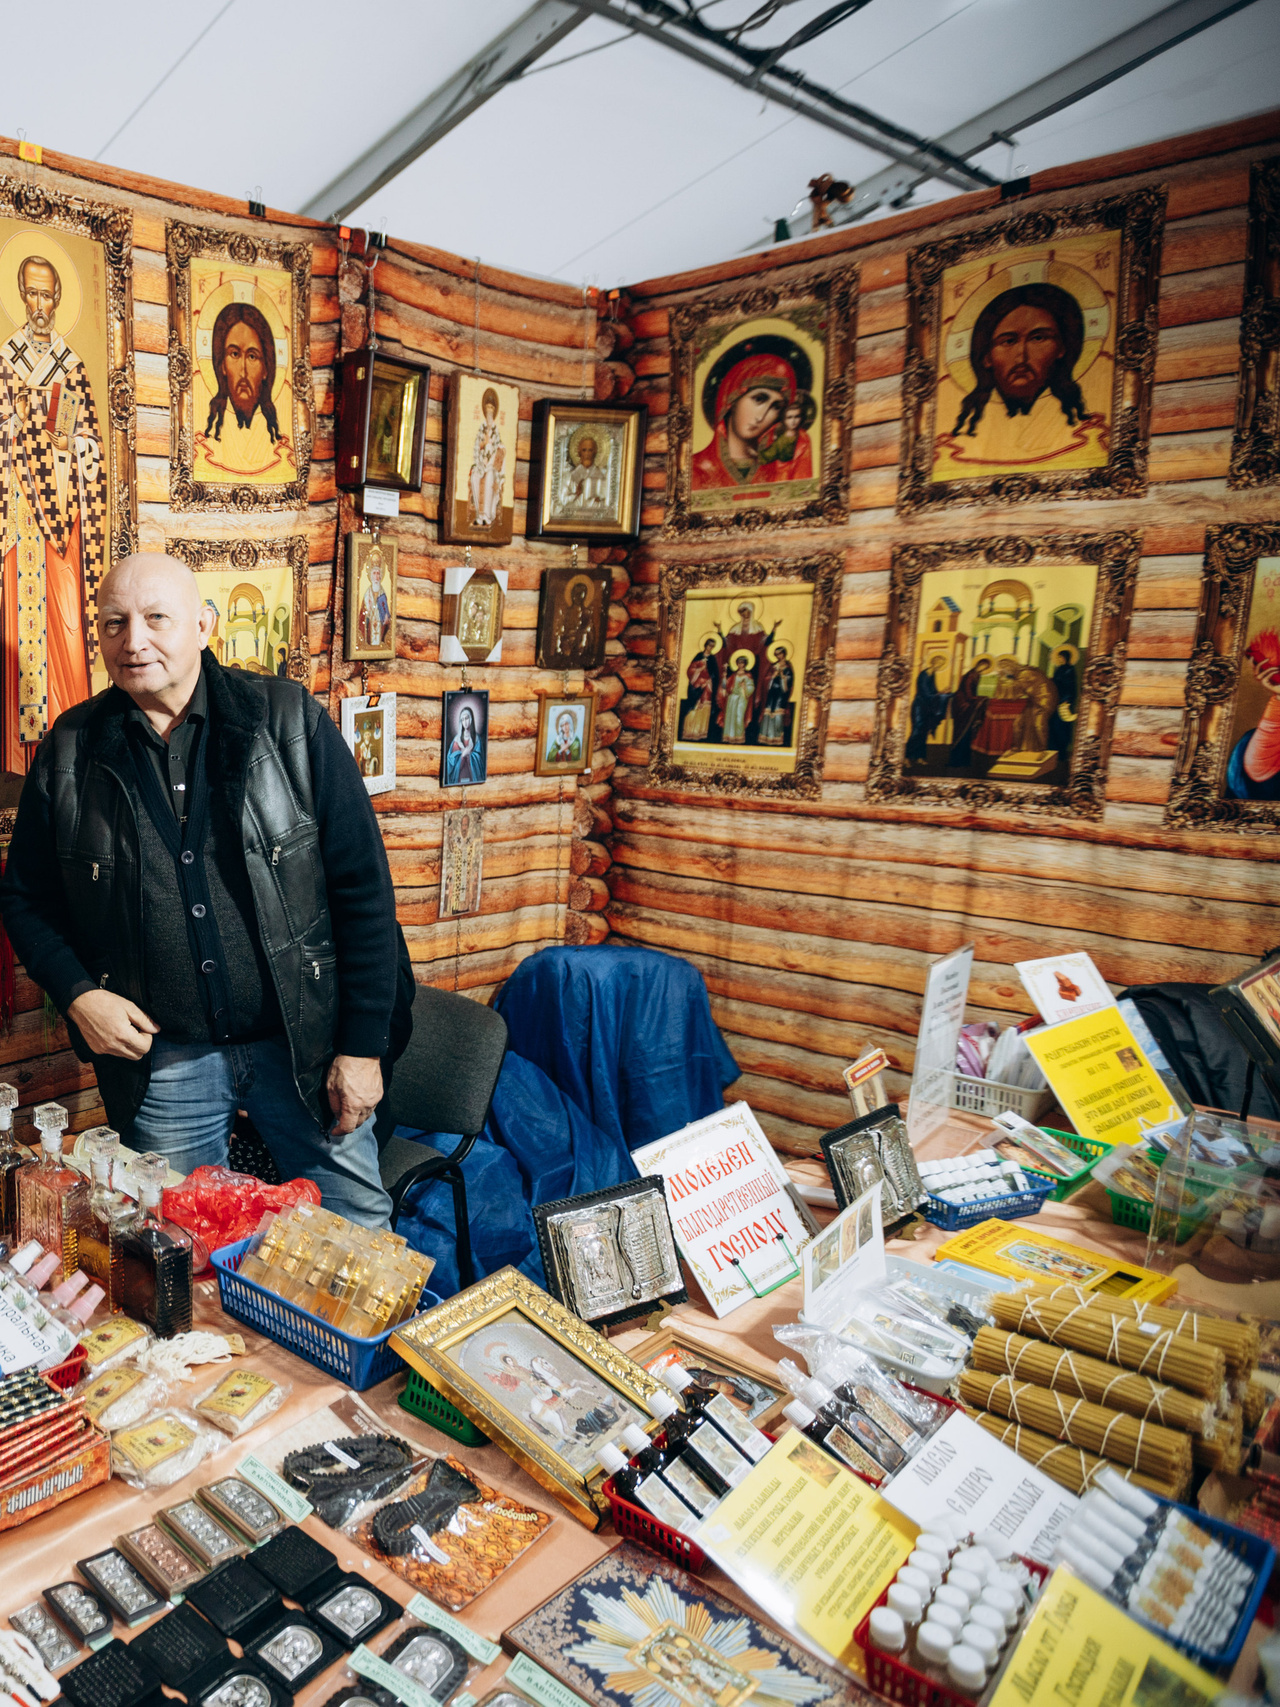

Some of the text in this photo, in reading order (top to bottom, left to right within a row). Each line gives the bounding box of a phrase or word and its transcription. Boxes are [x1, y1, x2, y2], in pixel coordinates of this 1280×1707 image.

[668, 1141, 756, 1202] МОЛЕБЕН
[677, 1168, 781, 1243] БЛАГОДАРСТВЕННЫЙ
[707, 1208, 793, 1273] ГОСПОДУ
[909, 1437, 960, 1485] МАСЛО
[7, 1464, 84, 1516] ФИЛЬЕРНЫЕ
[255, 1473, 294, 1509] АВТОМОБИЛЬ
[732, 1506, 755, 1530] МАСЛО
[752, 1476, 781, 1507] ЛАМПАДЫ
[766, 1501, 786, 1522] ГРОБА
[780, 1475, 807, 1506] ГОСПОДНЯ
[943, 1464, 996, 1516] С МИРО
[988, 1476, 1045, 1539] НИКОЛАЯ
[771, 1508, 804, 1547] ИЕРУСАЛИМ
[1007, 1582, 1081, 1703] Масло от Гроба
[1052, 1630, 1105, 1707] Господня
